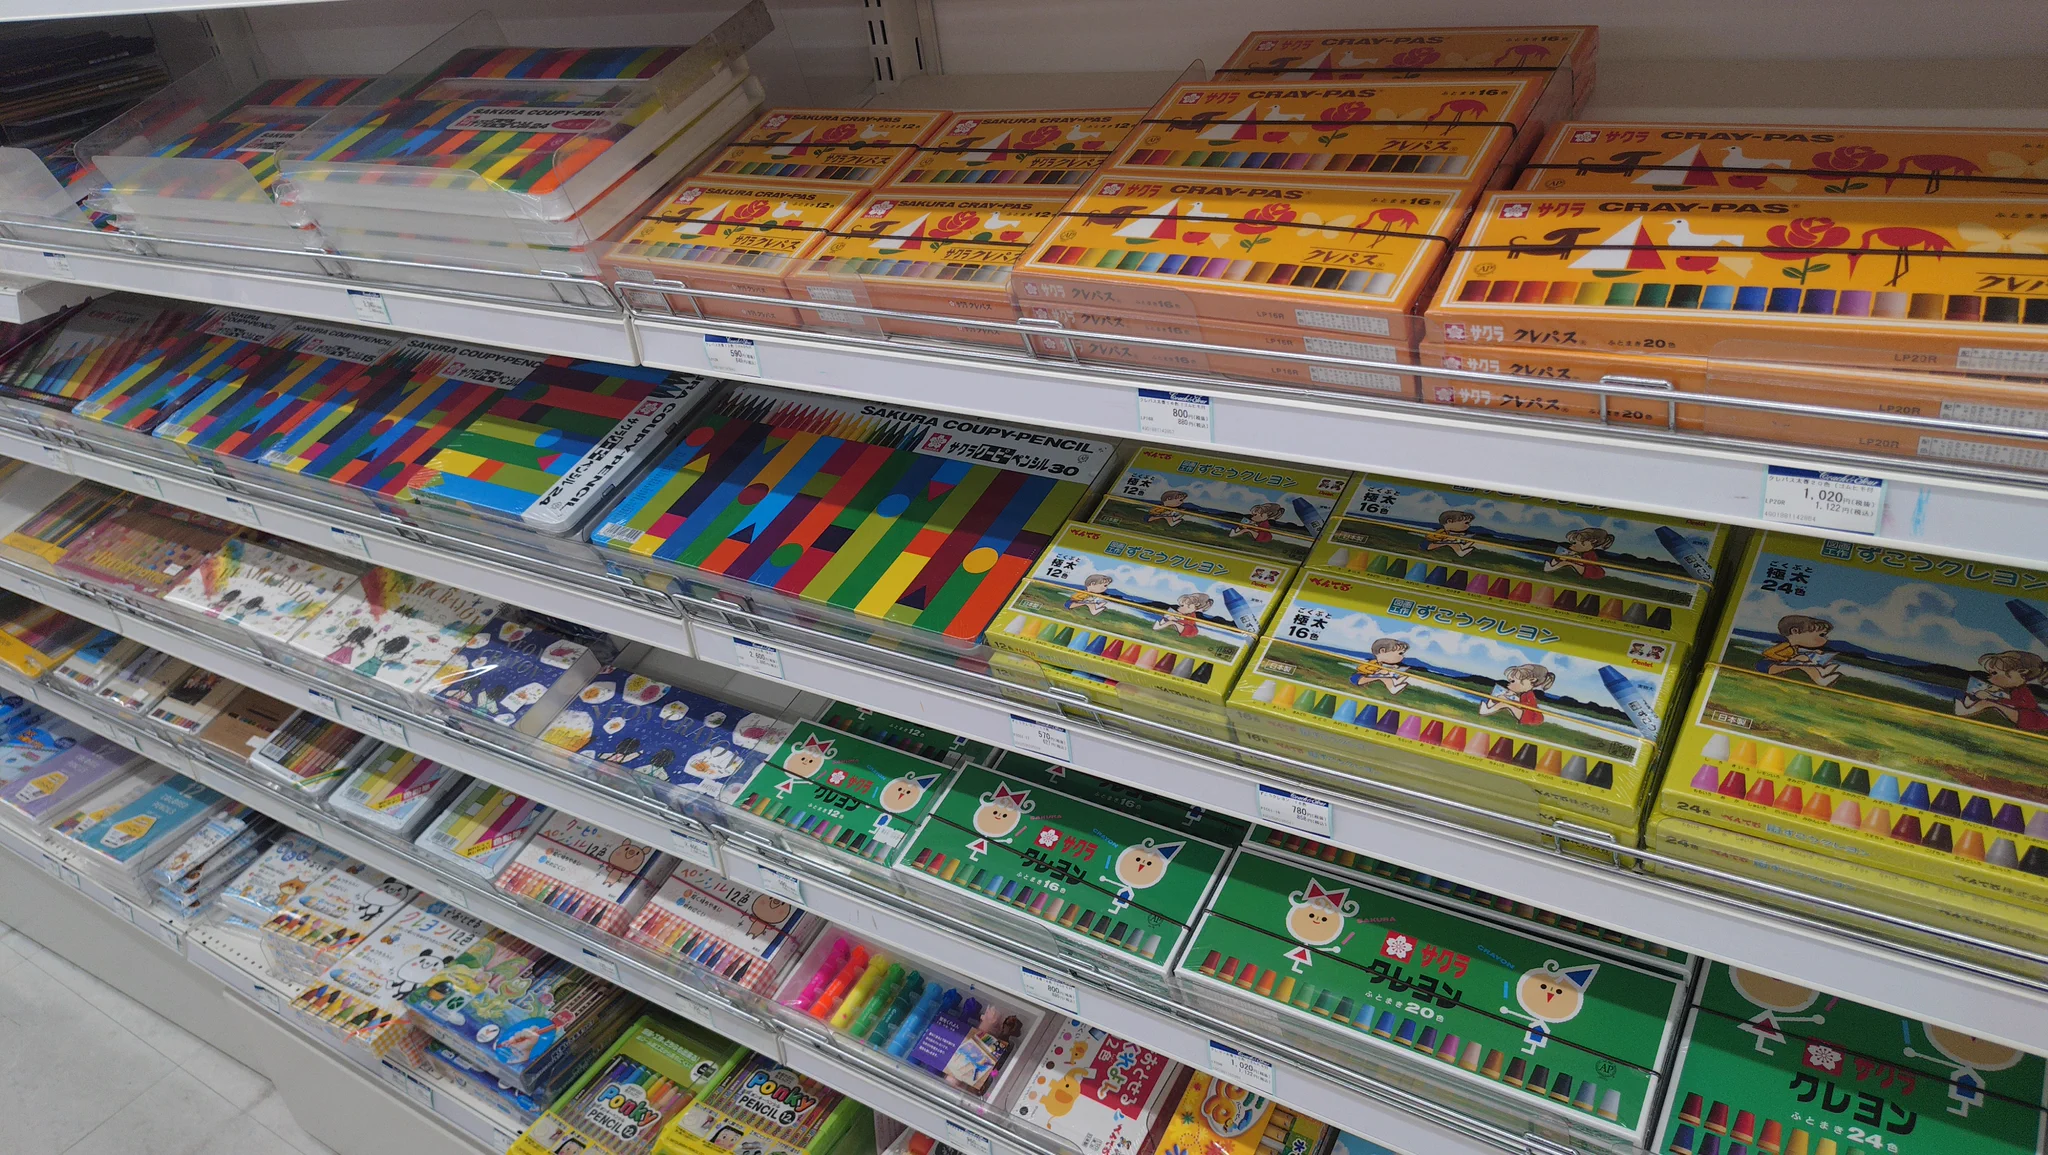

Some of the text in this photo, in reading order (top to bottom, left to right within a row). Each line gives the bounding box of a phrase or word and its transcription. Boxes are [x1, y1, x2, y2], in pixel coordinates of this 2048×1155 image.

[1280, 36, 1444, 50] サクラ CRAY-PAS
[1204, 88, 1377, 104] サクラ CRAY-PAS
[473, 108, 525, 116] SAKURA
[791, 114, 901, 123] SAKURA CRAY-PAS
[981, 116, 1112, 125] SAKURA CRAY-PAS
[1605, 131, 1836, 143] サクラ CRAY-PAS
[1379, 140, 1451, 152] クレパス
[705, 188, 816, 200] SAKURA CRAY-PAS
[1125, 184, 1305, 200] サクラ CRAY-PAS
[898, 200, 1032, 210] SAKURA CRAY-PAS
[1538, 202, 1791, 218] サクラ CRAY-PAS
[1304, 249, 1378, 266] クレパス
[1040, 283, 1114, 303] サクラ クレパス
[229, 311, 260, 322] SAKURA
[294, 324, 394, 347] SAKURA COUPY-PENCIL
[1470, 325, 1578, 344] サクラ クレパス
[407, 340, 458, 354] SAKURA
[1467, 358, 1499, 373] サクラ
[1894, 353, 1937, 364] LP20R
[1460, 388, 1561, 411] サクラ クレパス
[1878, 404, 1921, 415] LP20R
[861, 405, 1095, 455] SAKURA COUPY-PENCIL
[1859, 437, 1899, 448] LP20R
[566, 402, 677, 508] COUPY-PENCIL
[1126, 476, 1153, 489] 極太
[1198, 462, 1298, 488] ずこうクレヨン
[1123, 485, 1146, 497] 12色
[1363, 491, 1397, 506] 極太
[1358, 502, 1390, 515] 16色
[1051, 558, 1077, 571] 極太
[1126, 545, 1230, 576] ずこうクレヨン
[1770, 561, 1813, 573] ごくぶと
[1857, 546, 2048, 592] ずこうクレヨン
[1046, 567, 1069, 579] 12色
[1766, 566, 1810, 584] 極太
[1761, 580, 1806, 597] 24色
[1293, 613, 1328, 630] 極太
[1297, 607, 1333, 620] ごくぶと
[1416, 601, 1562, 646] ずこうクレヨン
[1288, 625, 1320, 641] 16色
[1631, 658, 1653, 668] Pentel
[1718, 713, 1747, 727] 日本製
[845, 775, 874, 795] サクラ
[813, 785, 861, 812] クレヨン
[1677, 801, 1712, 816] 24色
[1092, 828, 1119, 848] CRAYON
[1061, 835, 1098, 862] サクラ
[1020, 847, 1087, 885] クレヨン
[1016, 871, 1067, 894] ふとまき16色
[1356, 916, 1396, 924] SAKURA
[1420, 943, 1471, 979] サクラ
[1477, 944, 1515, 970] CRAYON
[1365, 958, 1463, 1009] クレヨン
[1364, 990, 1445, 1023] ふとまき20色
[1854, 1057, 1917, 1096] サクラ
[747, 1070, 817, 1113] Ponky
[598, 1085, 661, 1127] Ponky
[738, 1095, 779, 1120] PENCIL
[1789, 1072, 1918, 1136] クレヨン
[587, 1108, 628, 1134] PENCIL
[1791, 1111, 1899, 1154] ふとまき24色
